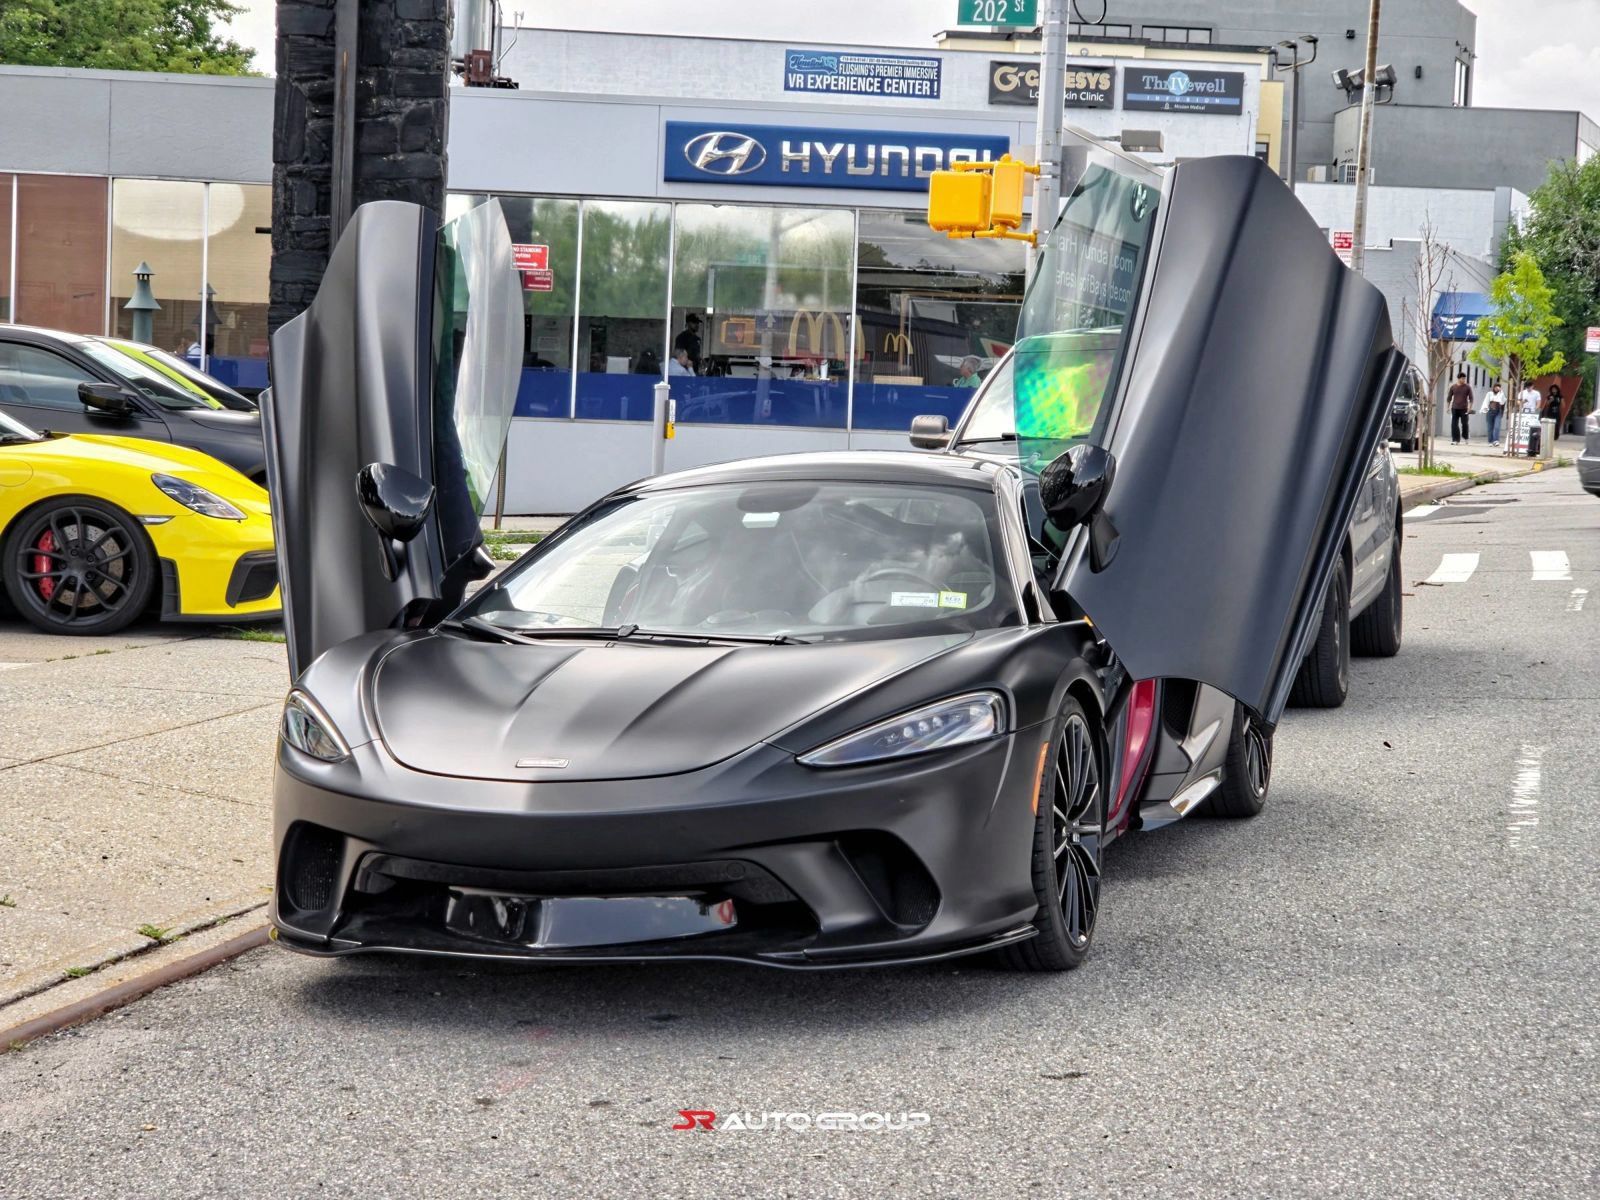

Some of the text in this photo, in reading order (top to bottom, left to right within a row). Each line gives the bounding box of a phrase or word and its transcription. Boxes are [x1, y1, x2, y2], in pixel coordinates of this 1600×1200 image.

[973, 0, 1025, 22] 202 St
[838, 63, 938, 79] FLUSHING'S PREMIER IMMERSIVE
[1024, 69, 1111, 90] GESYS
[788, 73, 804, 88] VR
[807, 75, 881, 92] EXPERIENCE
[884, 79, 930, 95] CENTER
[1065, 90, 1104, 101] kin Clinic
